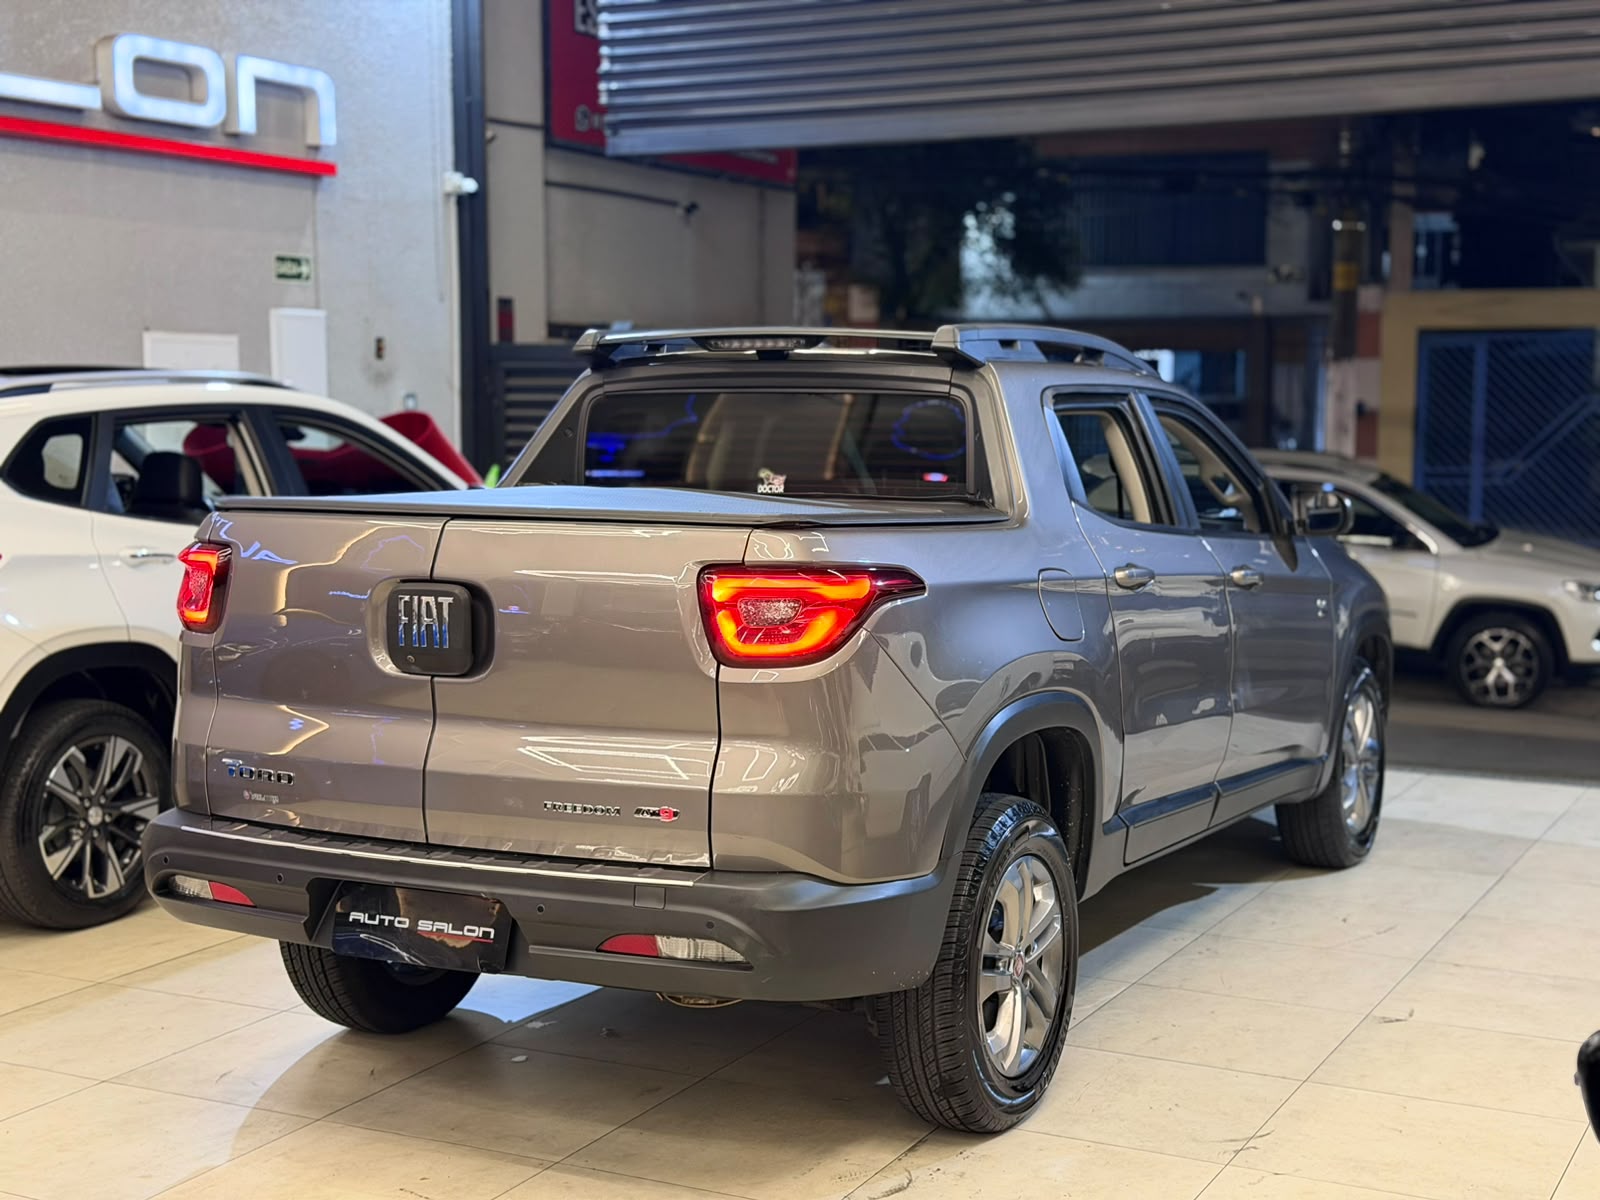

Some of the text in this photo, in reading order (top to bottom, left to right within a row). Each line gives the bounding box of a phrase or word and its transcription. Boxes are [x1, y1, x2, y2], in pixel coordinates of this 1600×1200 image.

[757, 484, 785, 494] DOCTOR
[398, 595, 454, 649] FIAT
[221, 758, 295, 786] TORO
[543, 800, 621, 817] FREEDOM
[349, 911, 495, 939] AUTO SALON
